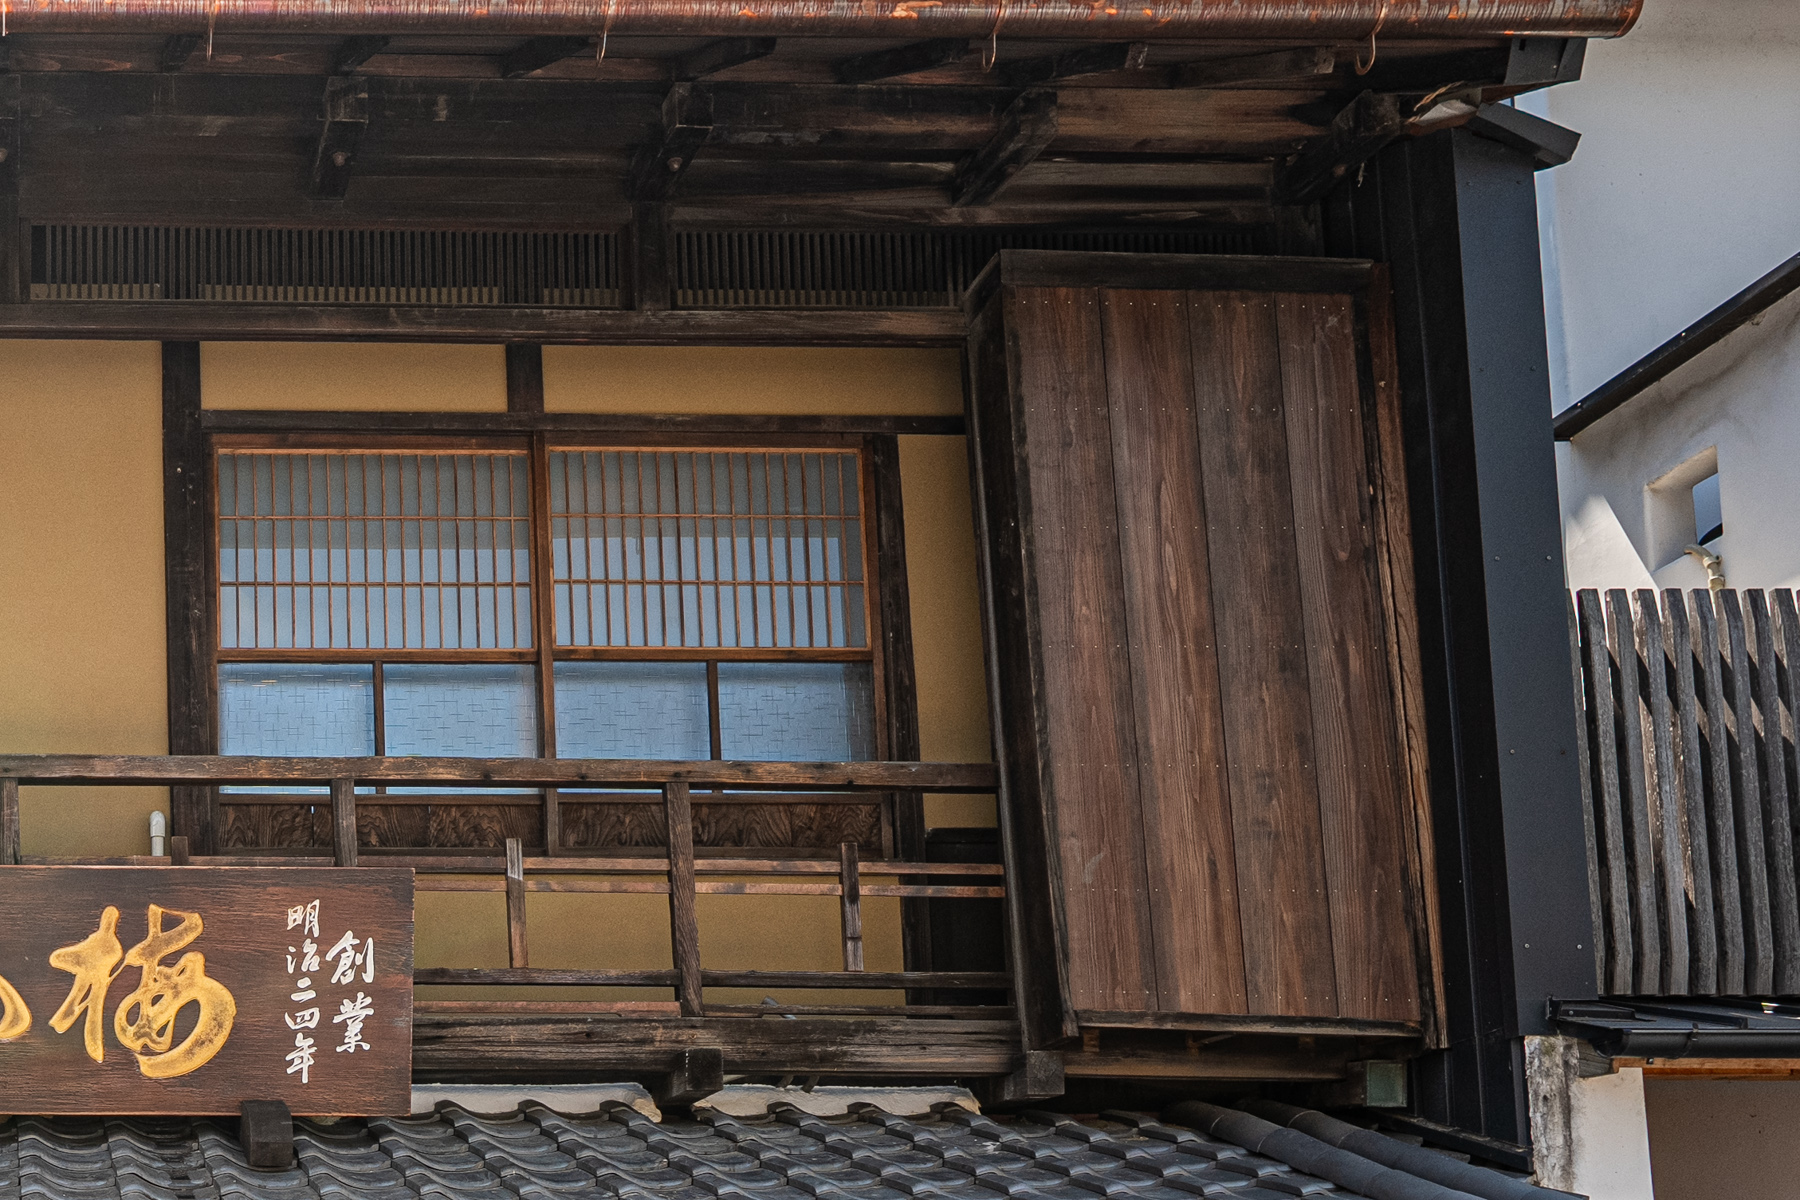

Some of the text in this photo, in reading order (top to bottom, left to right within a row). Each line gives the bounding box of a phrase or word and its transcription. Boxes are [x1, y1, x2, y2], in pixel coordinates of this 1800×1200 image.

[285, 899, 320, 1084] 明治二四年
[326, 930, 374, 1053] 創業
